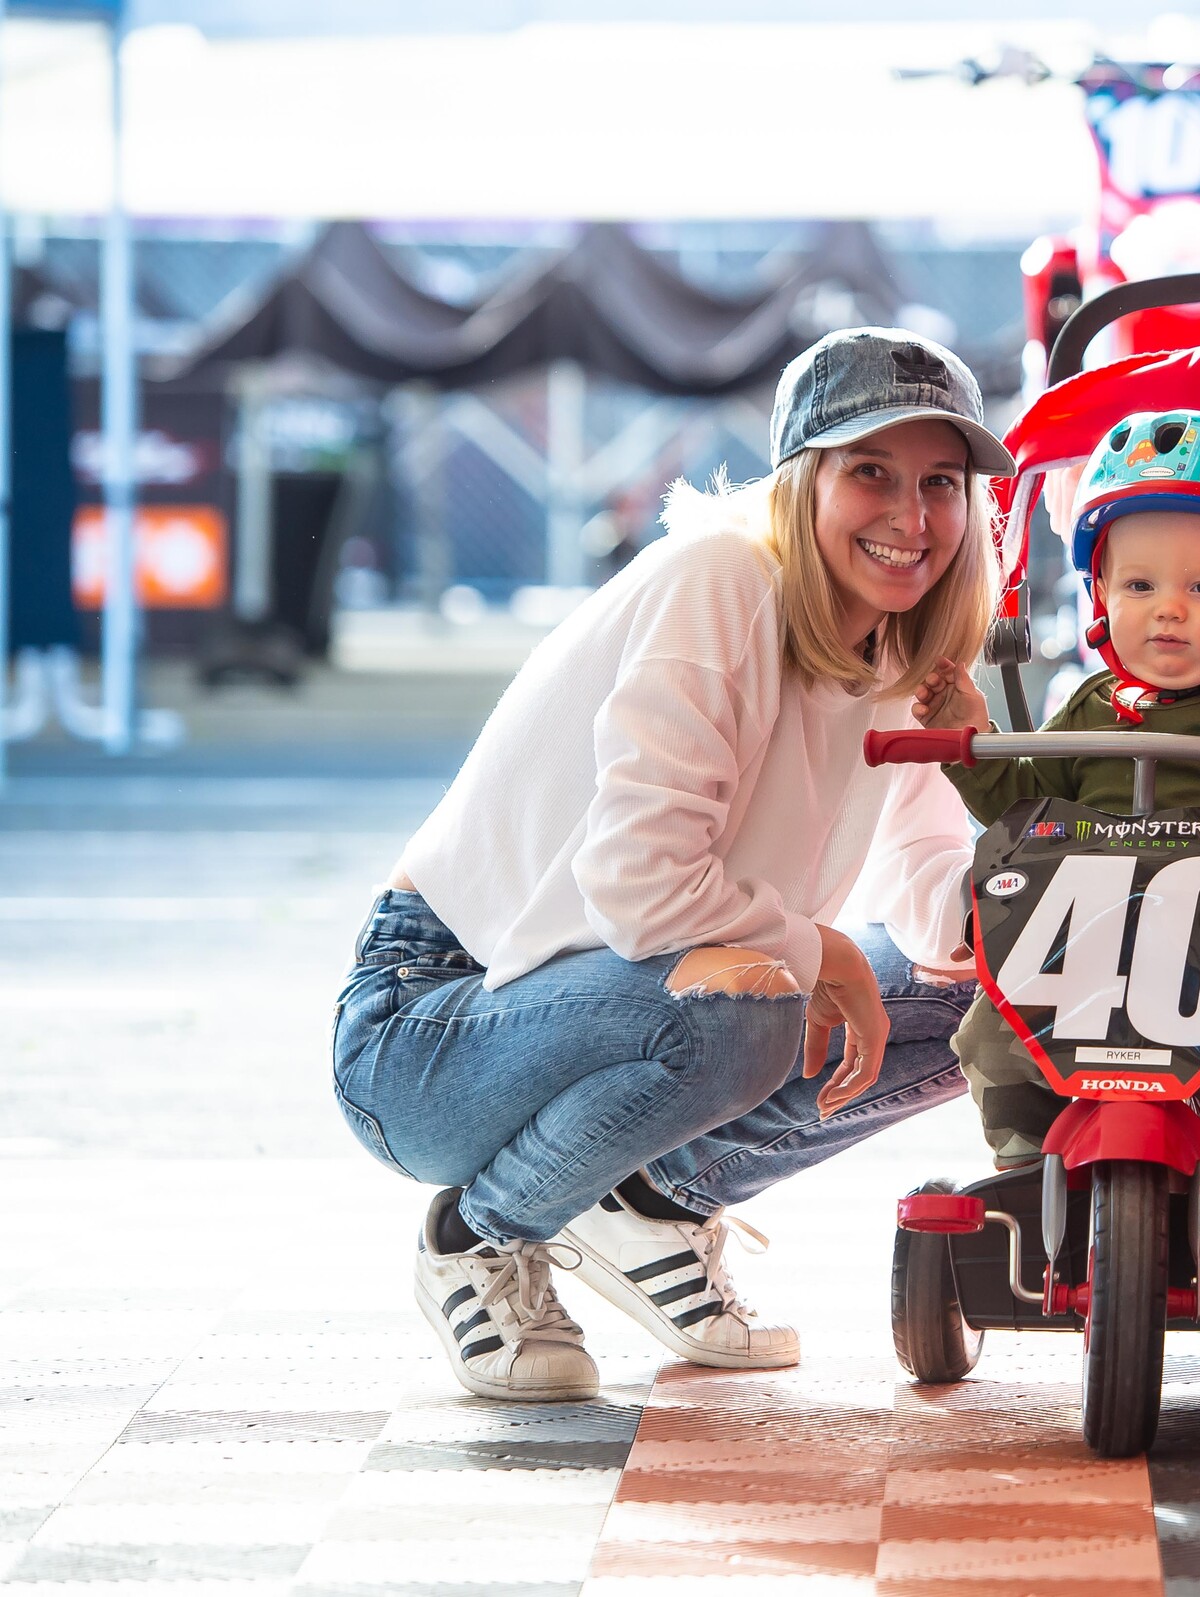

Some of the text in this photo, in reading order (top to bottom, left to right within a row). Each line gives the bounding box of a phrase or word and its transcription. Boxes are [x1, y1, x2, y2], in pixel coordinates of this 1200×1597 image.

[1022, 821, 1066, 839] AMA
[1109, 840, 1190, 848] ENERGY
[992, 877, 1019, 891] AMA
[1106, 1050, 1141, 1061] RYKER
[1080, 1079, 1167, 1093] HONDA
